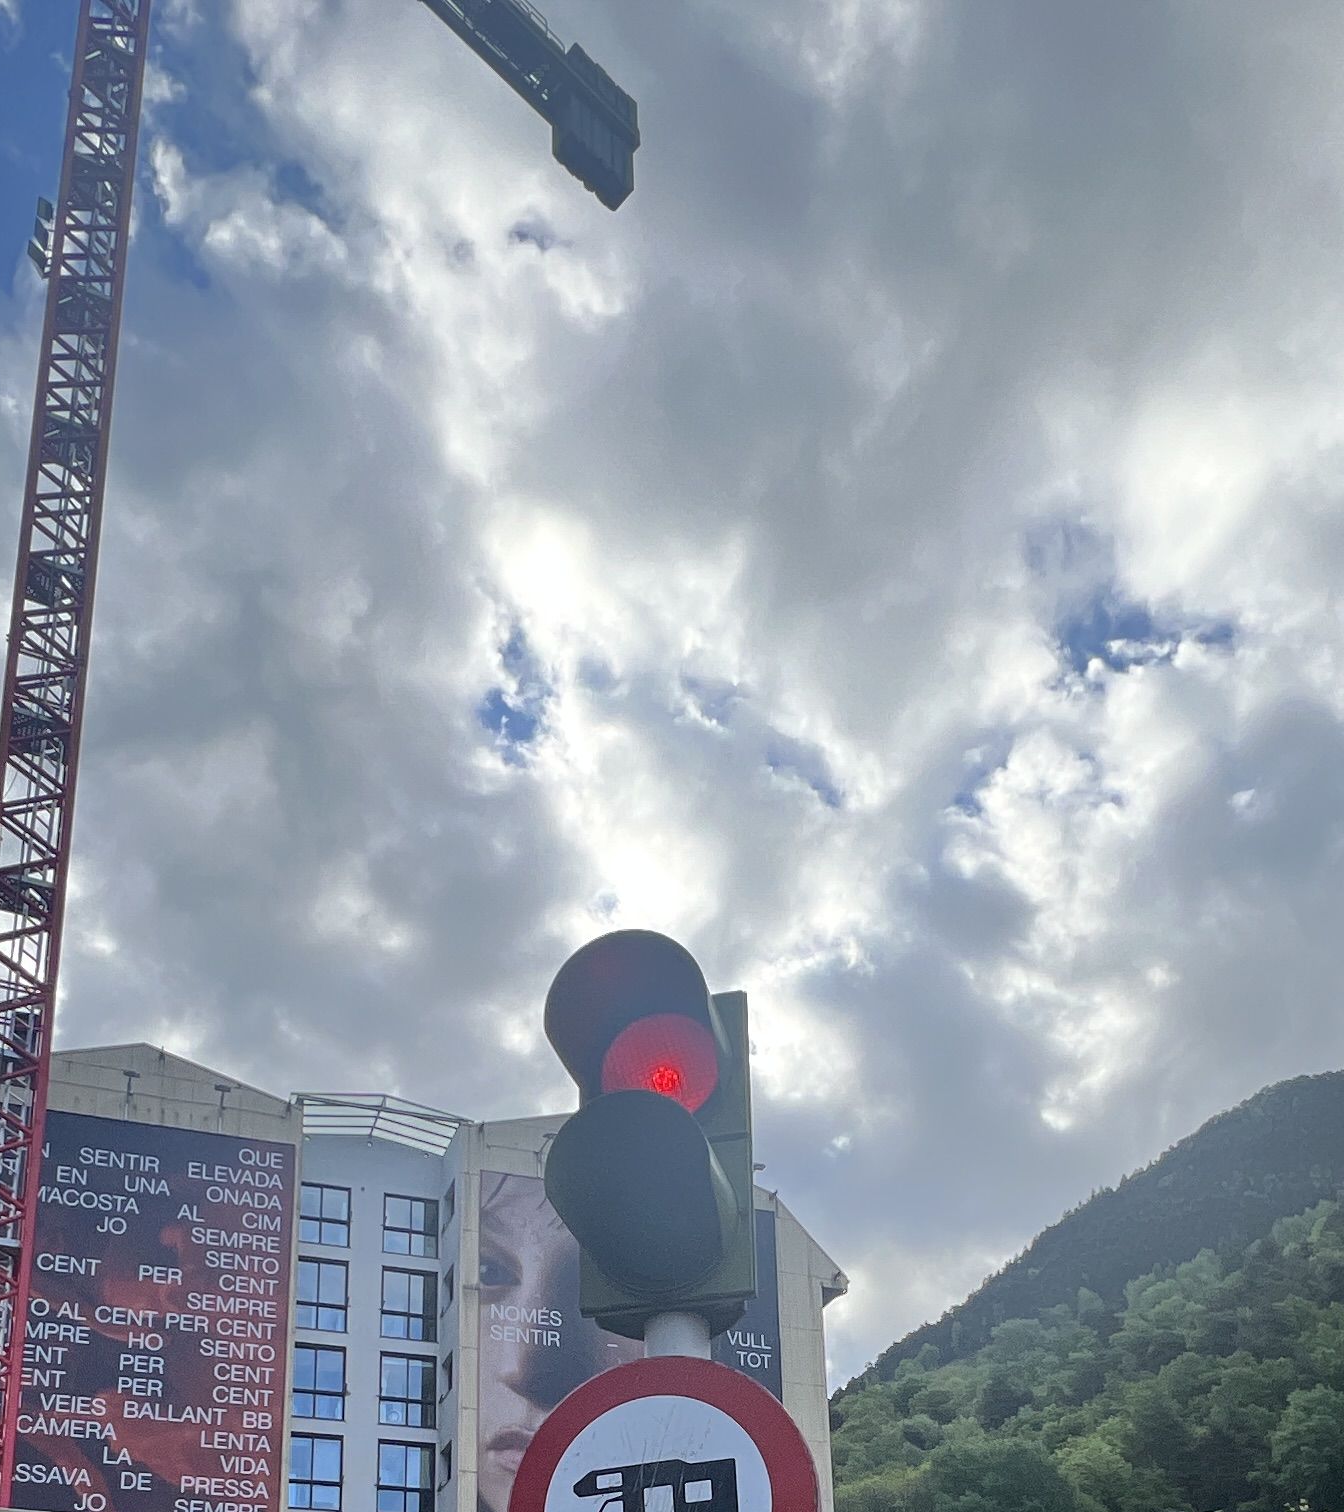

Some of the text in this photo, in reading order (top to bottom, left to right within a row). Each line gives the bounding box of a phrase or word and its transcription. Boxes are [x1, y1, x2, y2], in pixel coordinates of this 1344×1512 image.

[79, 1148, 160, 1173] SENTIR
[188, 1162, 283, 1190] ELEVADA
[238, 1149, 283, 1169] QUE
[56, 1166, 283, 1211] EN UNA ONADA
[96, 1216, 281, 1254] JO SEMPRE
[177, 1204, 205, 1223] AL
[242, 1212, 281, 1231] CIM
[36, 1253, 279, 1296] CENT PER CENT
[205, 1251, 280, 1274] SENTO
[57, 1301, 87, 1321] AL
[95, 1305, 159, 1328] CENT
[165, 1312, 209, 1333] PER
[216, 1318, 277, 1340] CENT
[187, 1292, 278, 1319] SEMPRE
[128, 1332, 276, 1361] HO SENTO
[490, 1304, 772, 1351] NOMÉS VULL
[5, 1342, 275, 1385] ENT PER CENT
[490, 1325, 772, 1369] SENTIR TOT
[2, 1366, 274, 1407] ENT PER CENT
[40, 1392, 107, 1417] VEIES
[123, 1400, 228, 1426] BALLANT
[242, 1411, 273, 1430] BB
[16, 1412, 117, 1441] CÀMERA
[201, 1430, 271, 1453] LENTA
[103, 1446, 271, 1477] LA VIDA
[73, 1493, 106, 1512] JO
[120, 1472, 153, 1492] DE
[180, 1475, 270, 1500] PRESSA
